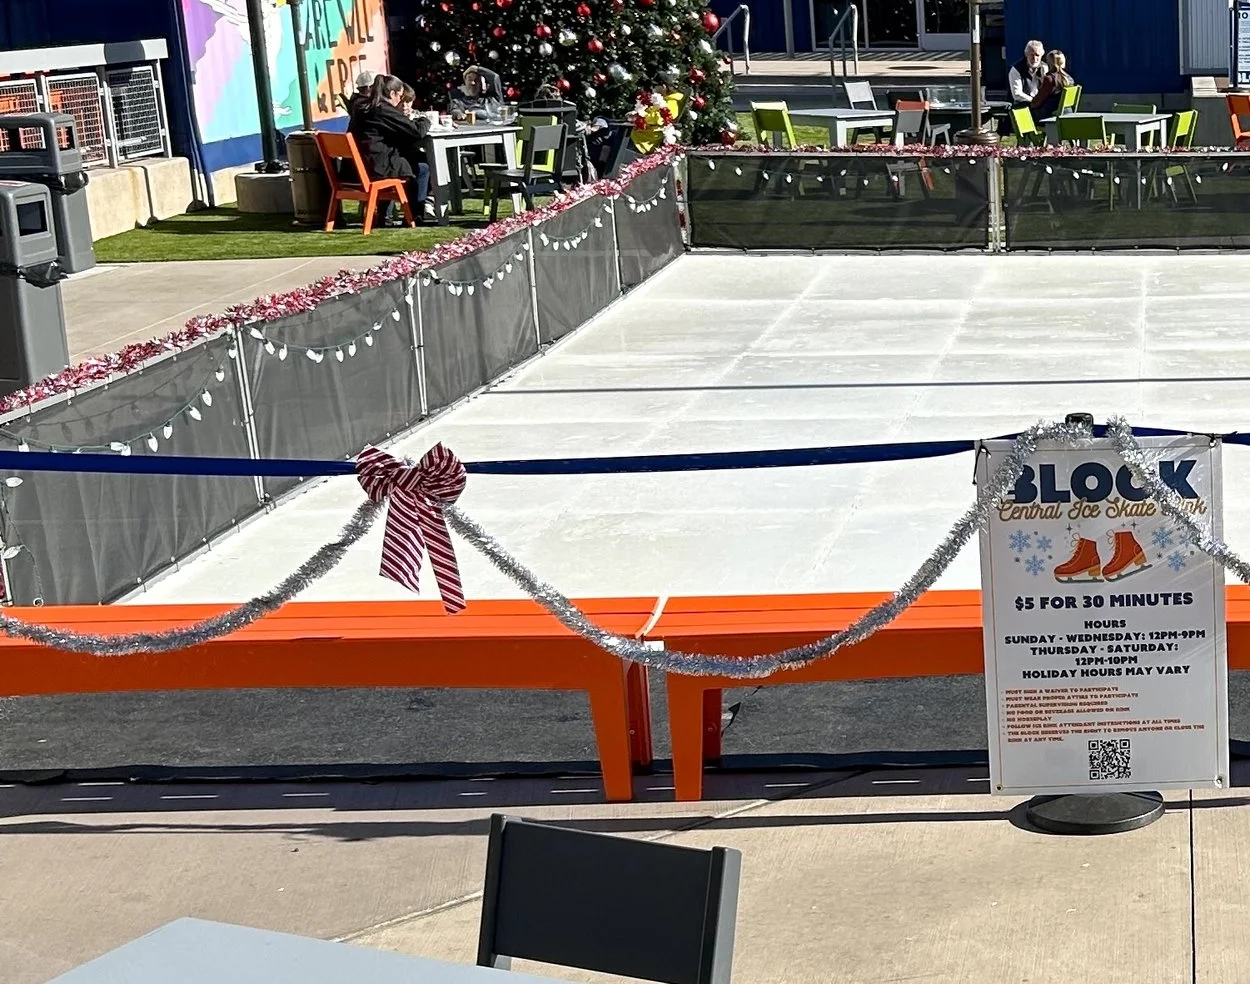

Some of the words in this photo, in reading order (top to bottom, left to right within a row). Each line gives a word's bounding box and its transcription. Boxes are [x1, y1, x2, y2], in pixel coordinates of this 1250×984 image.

[996, 499, 1063, 521] Central
[1067, 497, 1102, 520] Ice
[1105, 496, 1157, 519] Skate
[1014, 596, 1035, 611] $5
[1040, 595, 1078, 610] FOR
[1083, 594, 1104, 609] 30
[1110, 592, 1194, 608] MINUTES
[1084, 619, 1127, 629] HOURS
[1004, 634, 1056, 644] SUNDAY
[1066, 632, 1146, 643] WEDNESDAY:
[1148, 629, 1206, 640] 12PM-9PM
[1030, 645, 1097, 656] THURSDAY
[1107, 642, 1179, 653] SATURDAY:
[1075, 655, 1138, 666] 12PM-10PM
[1022, 669, 1077, 679] HOLIDAY
[1080, 668, 1123, 677] HOURS
[1125, 666, 1153, 676] MAY
[1156, 665, 1191, 675] VARY
